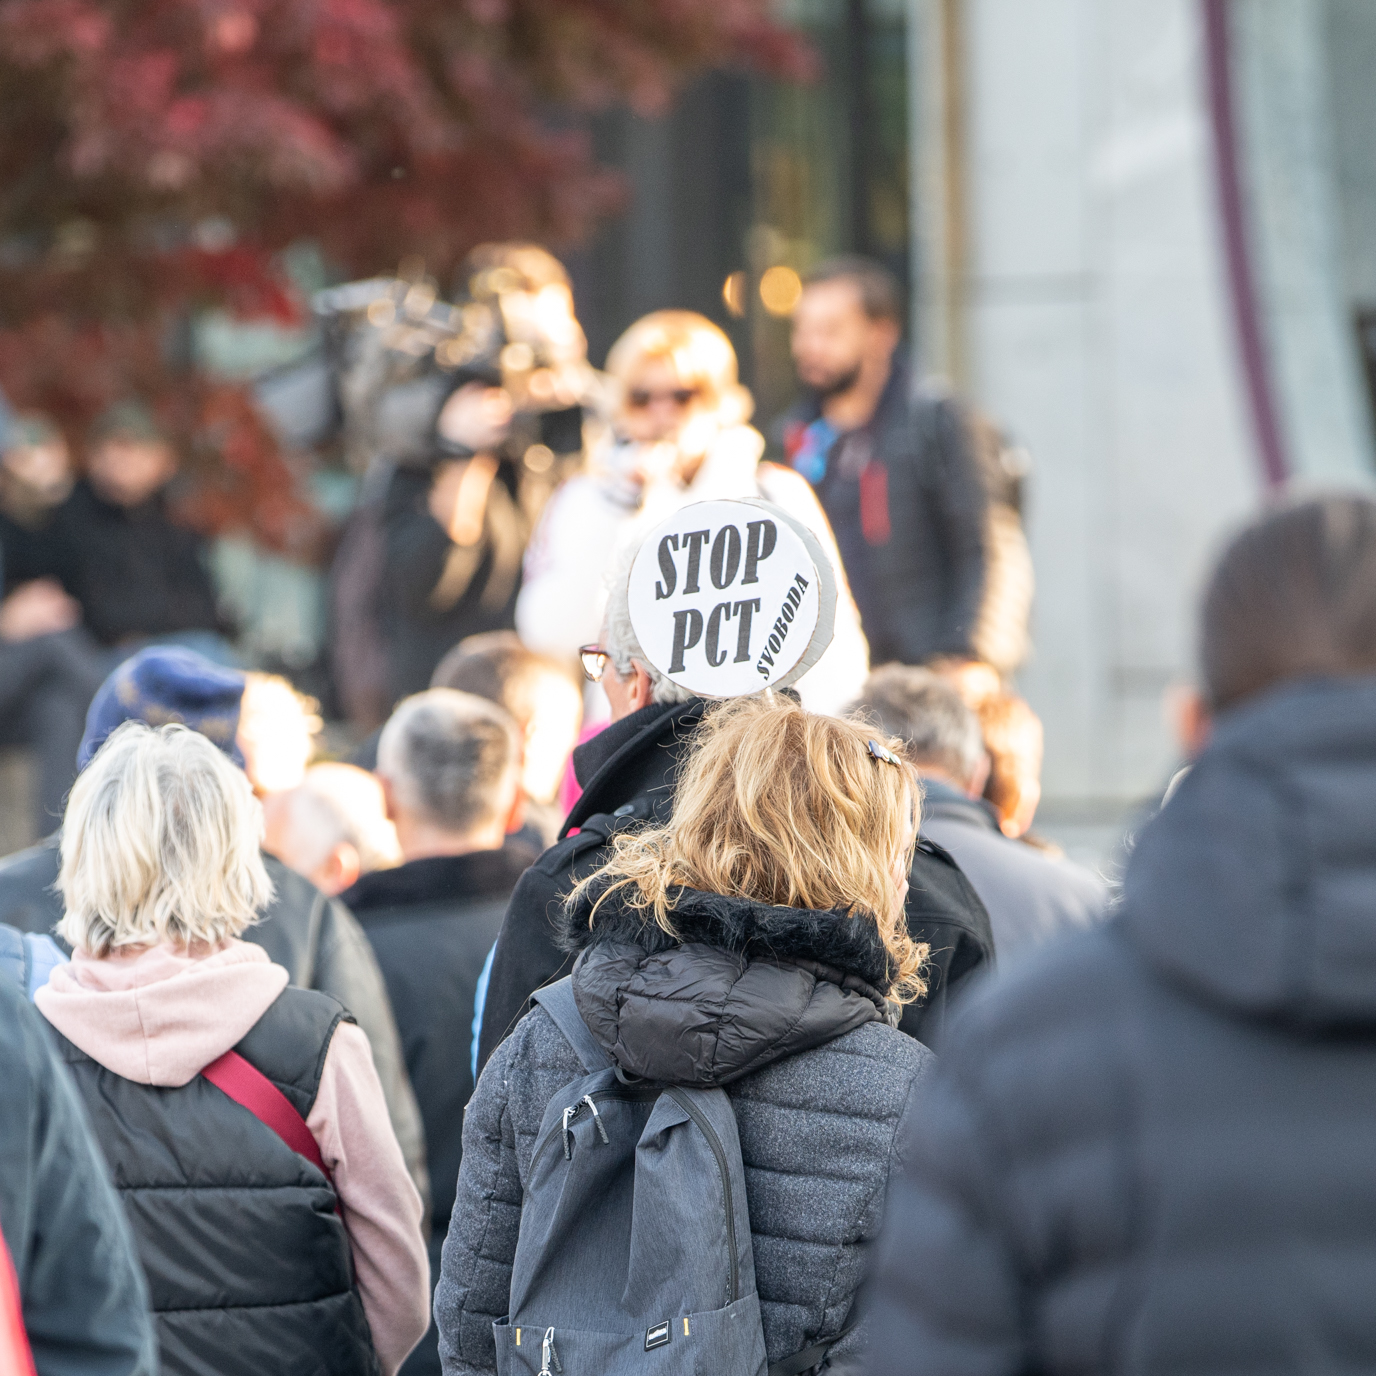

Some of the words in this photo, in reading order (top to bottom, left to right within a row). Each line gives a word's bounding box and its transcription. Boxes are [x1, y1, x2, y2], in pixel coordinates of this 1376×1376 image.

[656, 519, 777, 600] STOP
[668, 598, 760, 673] PCT
[756, 573, 809, 680] SVOBODA
